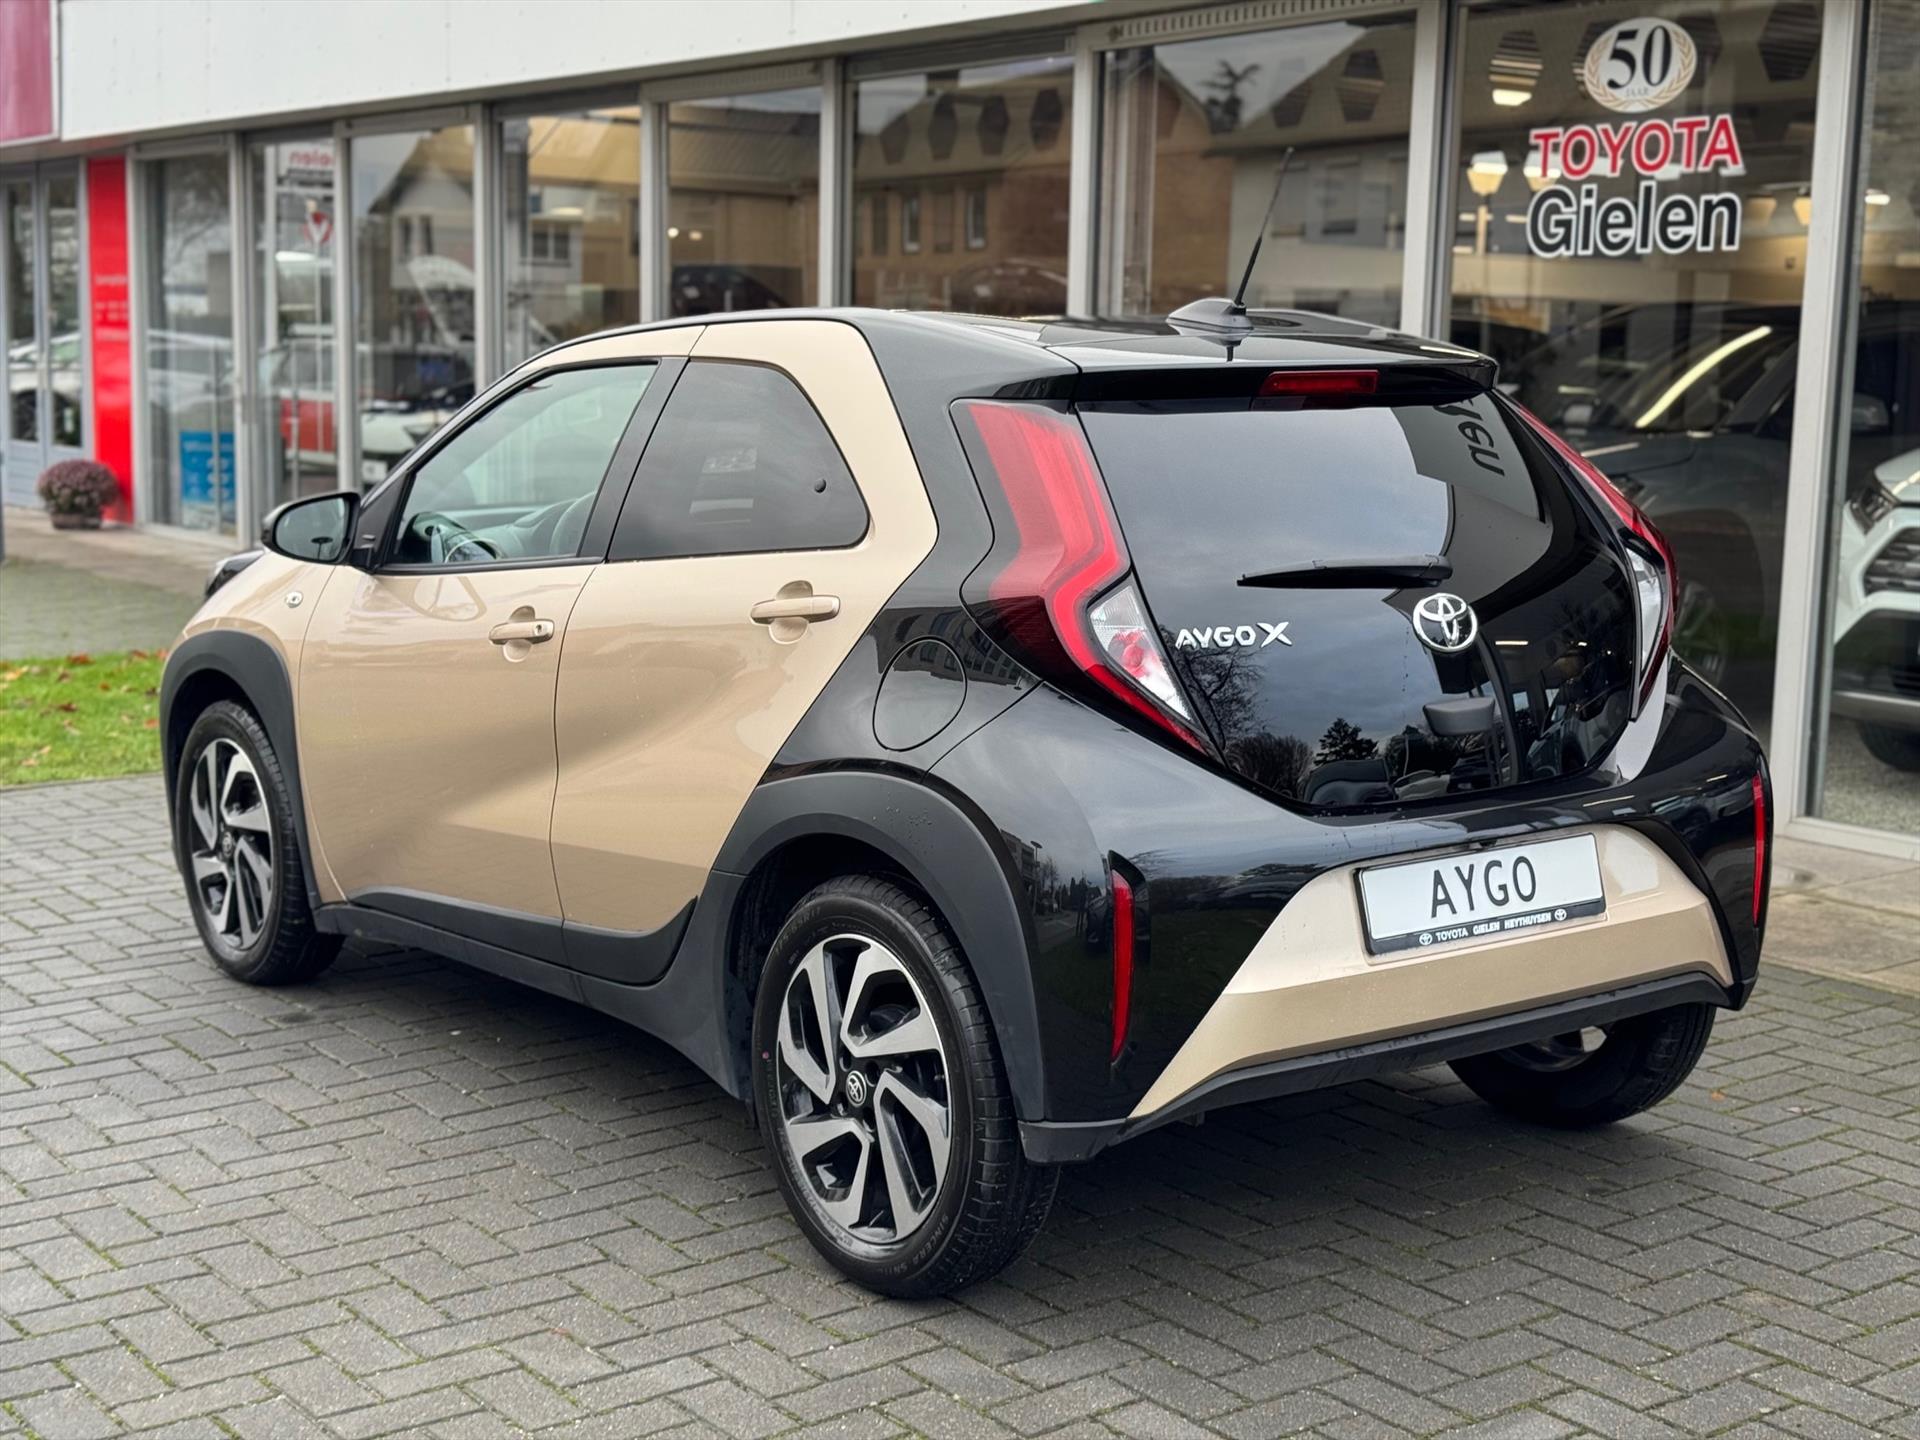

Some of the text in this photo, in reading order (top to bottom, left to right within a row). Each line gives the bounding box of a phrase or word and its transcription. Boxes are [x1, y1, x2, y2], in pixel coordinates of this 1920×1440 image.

[1607, 25, 1672, 89] 50
[1530, 114, 1742, 181] TOYOTA
[1526, 181, 1742, 259] Gielen
[1175, 621, 1293, 650] AYGO X
[1431, 856, 1537, 918] AYGO
[1435, 912, 1551, 942] TOYOTA GIELEN HEYTHUYSEN
